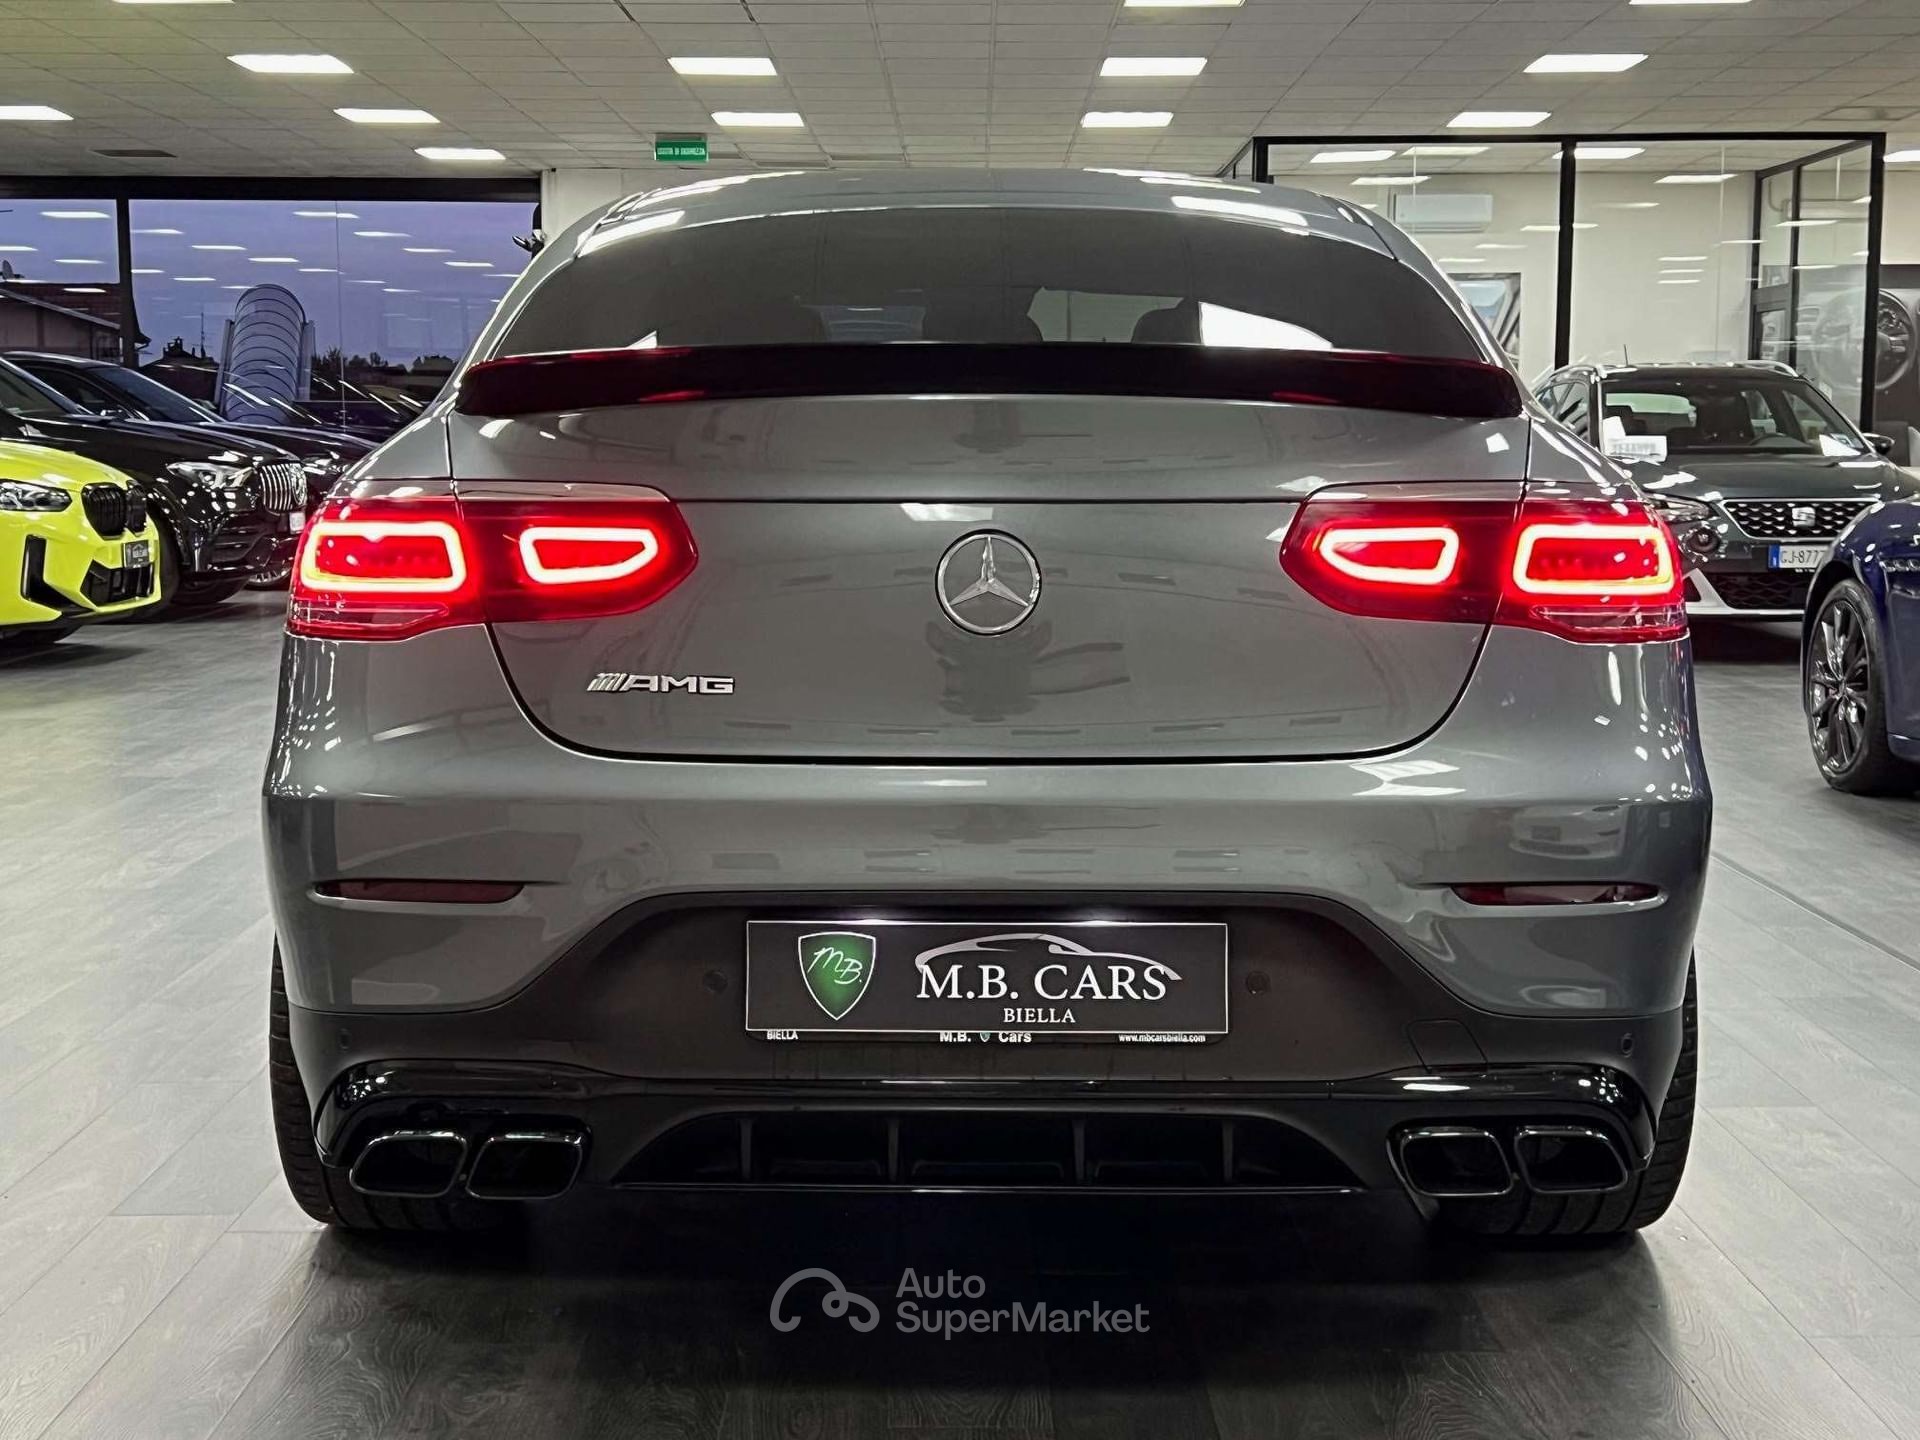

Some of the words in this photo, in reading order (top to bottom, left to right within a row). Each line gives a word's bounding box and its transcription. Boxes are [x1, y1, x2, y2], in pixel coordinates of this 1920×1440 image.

[619, 674, 734, 694] AMG
[916, 964, 1019, 1000] M.B.
[1034, 964, 1167, 1000] CARS
[1003, 1008, 1076, 1023] BIELLA
[766, 1030, 799, 1040] BIELLA
[940, 1032, 972, 1042] M.B.
[999, 1032, 1032, 1043] Cars
[1118, 1033, 1206, 1043] www.mbcarsbiella.com
